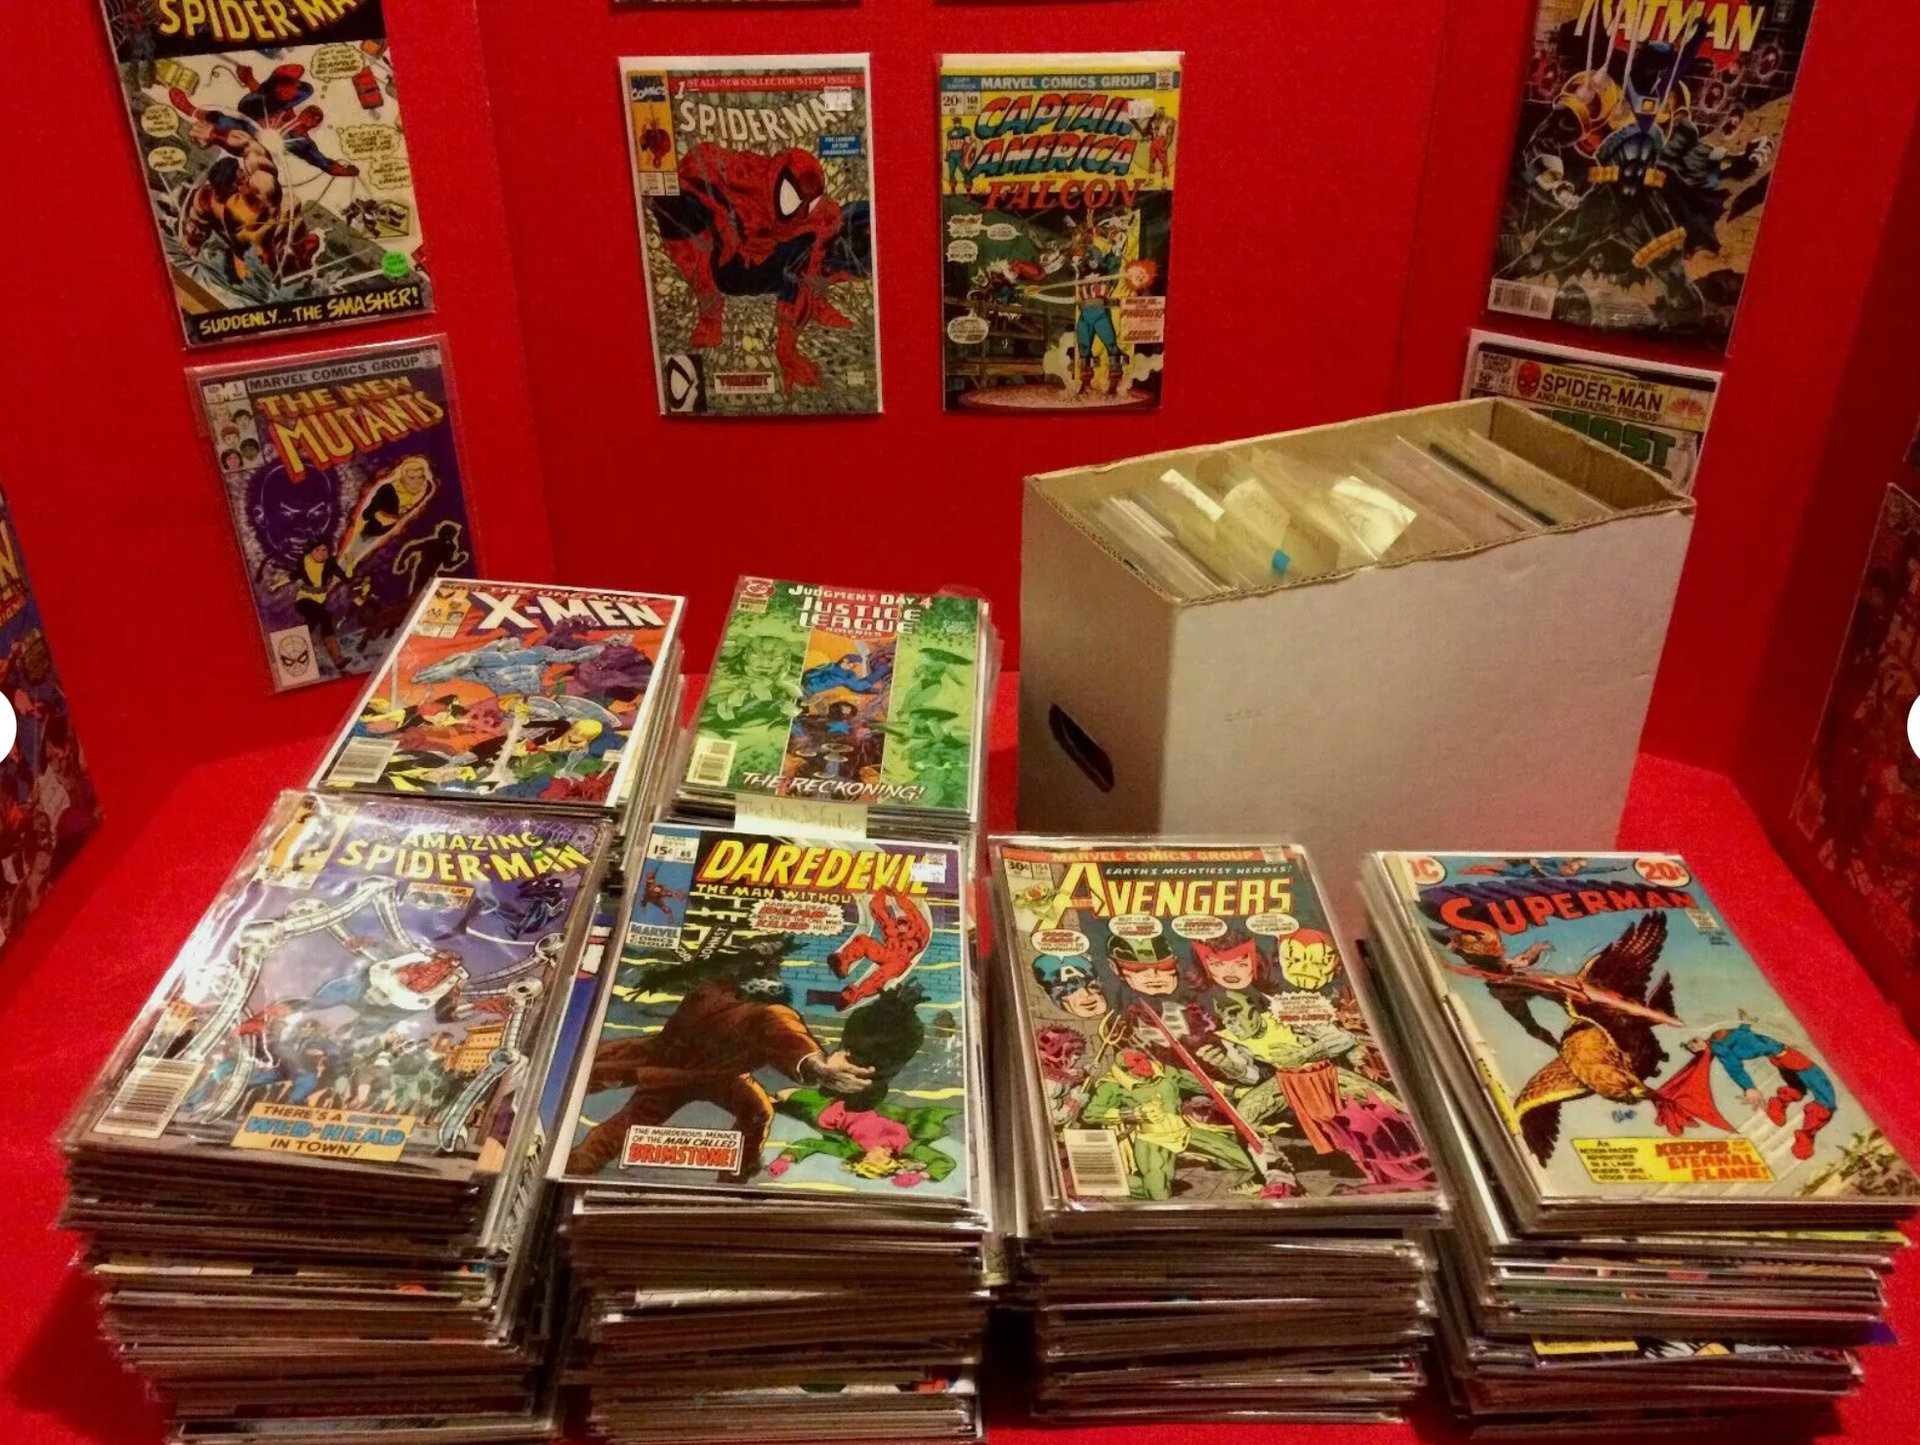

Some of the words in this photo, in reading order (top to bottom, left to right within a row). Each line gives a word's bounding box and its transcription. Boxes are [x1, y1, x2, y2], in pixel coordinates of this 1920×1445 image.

[981, 77, 1037, 89] MARVEL
[1041, 76, 1096, 89] COMICS
[1101, 75, 1151, 88] GROUP
[679, 95, 847, 141] SPIDER-MA
[967, 133, 1137, 182] AMERICA
[982, 179, 1146, 211] FALCON
[326, 286, 419, 318] SMASHER!
[250, 374, 309, 390] MARVEL
[312, 364, 367, 381] COMICS
[371, 355, 419, 372] GROUP
[256, 388, 336, 416] THE
[337, 376, 412, 404] NEW
[1541, 373, 1663, 412] SPIDER-MAN
[1572, 398, 1616, 414] AMAZING
[270, 391, 444, 484] MUTANTS
[491, 586, 530, 595] THE
[539, 591, 648, 604] UNCANNY
[788, 585, 876, 602] JUDGMENT
[880, 594, 915, 606] DAY
[919, 596, 933, 609] 4
[471, 591, 665, 629] X-MEN
[797, 596, 921, 622] JUSTICE
[800, 611, 915, 634] LEAGUE
[743, 772, 785, 789] THE
[788, 777, 926, 800] RECKONING!
[402, 832, 544, 851] AMAZING
[337, 839, 592, 882] SPIDER-MAN
[1052, 852, 1116, 862] MARVEL
[1126, 851, 1190, 862] COMICS
[1197, 851, 1254, 861] GROUP
[1162, 866, 1231, 875] MIGHTIEST
[1237, 865, 1292, 875] HEROES!
[697, 884, 728, 895] THE
[733, 887, 779, 899] MAN
[1035, 862, 1293, 931] AVENGERS
[1440, 890, 1697, 935] SUPERMAN
[631, 922, 678, 938] MARVEL
[264, 1106, 328, 1121] THERE'S
[329, 1113, 342, 1122] A
[245, 1117, 406, 1146] WEB-HEAD
[652, 1129, 703, 1138] MURDEROUS
[705, 1131, 738, 1139] MENACE
[663, 1137, 691, 1145] MAN
[693, 1139, 737, 1148] CALLED
[271, 1138, 289, 1149] IN
[295, 1142, 362, 1156] TOWN!
[629, 1142, 737, 1167] BRIMSTONE!
[1655, 1141, 1729, 1157] KEEPER
[1668, 1154, 1760, 1170] ETERNAL
[1691, 1167, 1770, 1181] FLAME!
